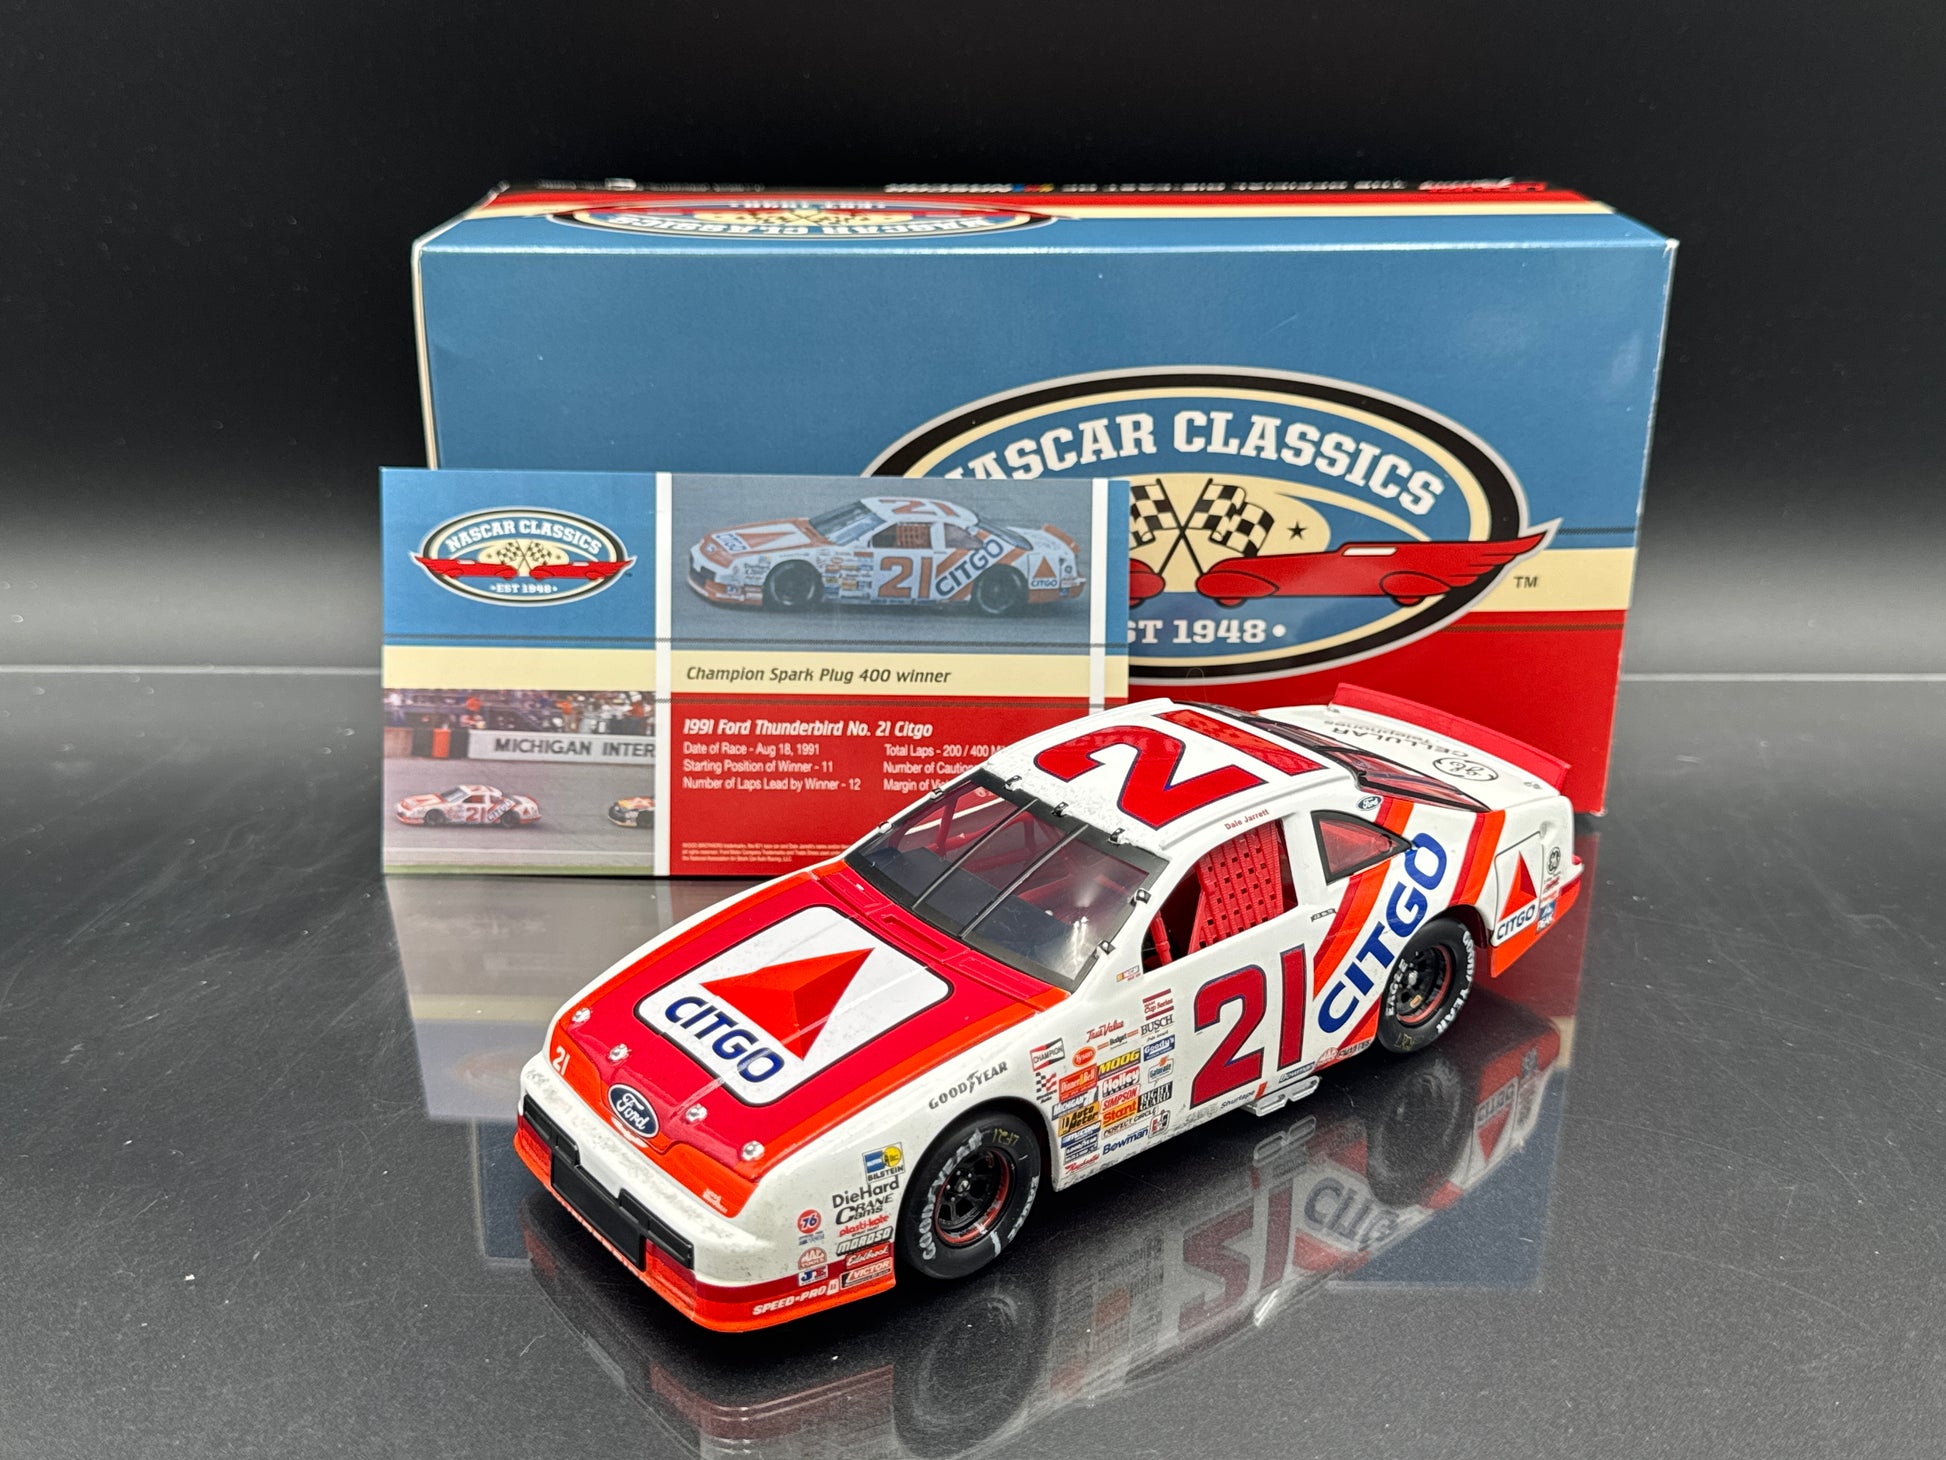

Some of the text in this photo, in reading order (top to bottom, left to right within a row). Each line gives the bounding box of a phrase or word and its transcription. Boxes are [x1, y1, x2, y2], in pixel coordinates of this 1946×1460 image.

[944, 411, 1447, 517] ASCAR CLASSICS
[445, 518, 602, 554] NASCAR CLASSICS
[878, 556, 934, 599] 21
[935, 538, 1004, 597] CITGO
[1030, 578, 1058, 588] CITGO
[1172, 619, 1268, 644] 1948
[686, 666, 952, 685] Champion Spark Plug 400 winner
[683, 718, 934, 740] 1991 Ford Thunderbird No. 21 Citgo
[495, 738, 593, 756] MICHIGAN
[683, 742, 707, 755] Date
[708, 742, 720, 755] of
[721, 742, 748, 755] Race
[756, 743, 777, 758] Aug
[779, 743, 794, 757] 18,
[796, 743, 820, 756] 1991
[884, 744, 909, 757] Total
[909, 744, 935, 759] Laps
[943, 744, 962, 757] 200
[963, 744, 968, 757] /
[970, 744, 989, 757] 400
[683, 759, 722, 775] Starting
[723, 759, 764, 773] Position
[765, 760, 776, 773] of
[778, 760, 813, 774] Winner
[821, 760, 834, 773] 11
[883, 761, 924, 774] Number
[924, 761, 935, 774] of
[1032, 708, 1330, 831] 21
[683, 776, 722, 789] Number
[724, 776, 736, 789] of
[737, 776, 762, 792] Laps
[763, 777, 789, 790] Lead
[790, 777, 803, 792] by
[804, 778, 840, 791] Winner
[848, 778, 861, 791] 12
[884, 778, 918, 794] Margin
[918, 778, 930, 791] of
[465, 806, 487, 821] 21
[1224, 808, 1270, 830] Dale Jarrett
[1318, 832, 1448, 1034] CITGO
[1497, 904, 1536, 940] CITGO
[1385, 958, 1408, 1017] EAGLE
[1141, 1013, 1174, 1036] BUSCH
[1189, 943, 1308, 1110] 21
[665, 995, 786, 1084] CITGO
[552, 1045, 571, 1077] 21
[1033, 1045, 1064, 1064] CHAMPION
[1076, 1050, 1093, 1064] Tyson
[1099, 1050, 1140, 1074] MOOG
[928, 1061, 1008, 1110] GOODYEAR
[1102, 1070, 1140, 1093] Holley
[1103, 1087, 1138, 1111] SIMPSON
[616, 1092, 650, 1131] Ford
[1072, 1105, 1095, 1121] Auto
[1102, 1100, 1137, 1124] Stant
[1103, 1127, 1149, 1156] Bowman
[867, 1165, 904, 1182] BILSTEIN
[832, 1174, 900, 1209] DieHard
[838, 1214, 890, 1238] plasti-kote
[838, 1228, 892, 1255] MOROSO
[801, 1248, 824, 1262] MAC
[847, 1245, 889, 1266] Edelbrock
[855, 1260, 890, 1278] VICTOR
[752, 1285, 827, 1316] SPEED-PRO
